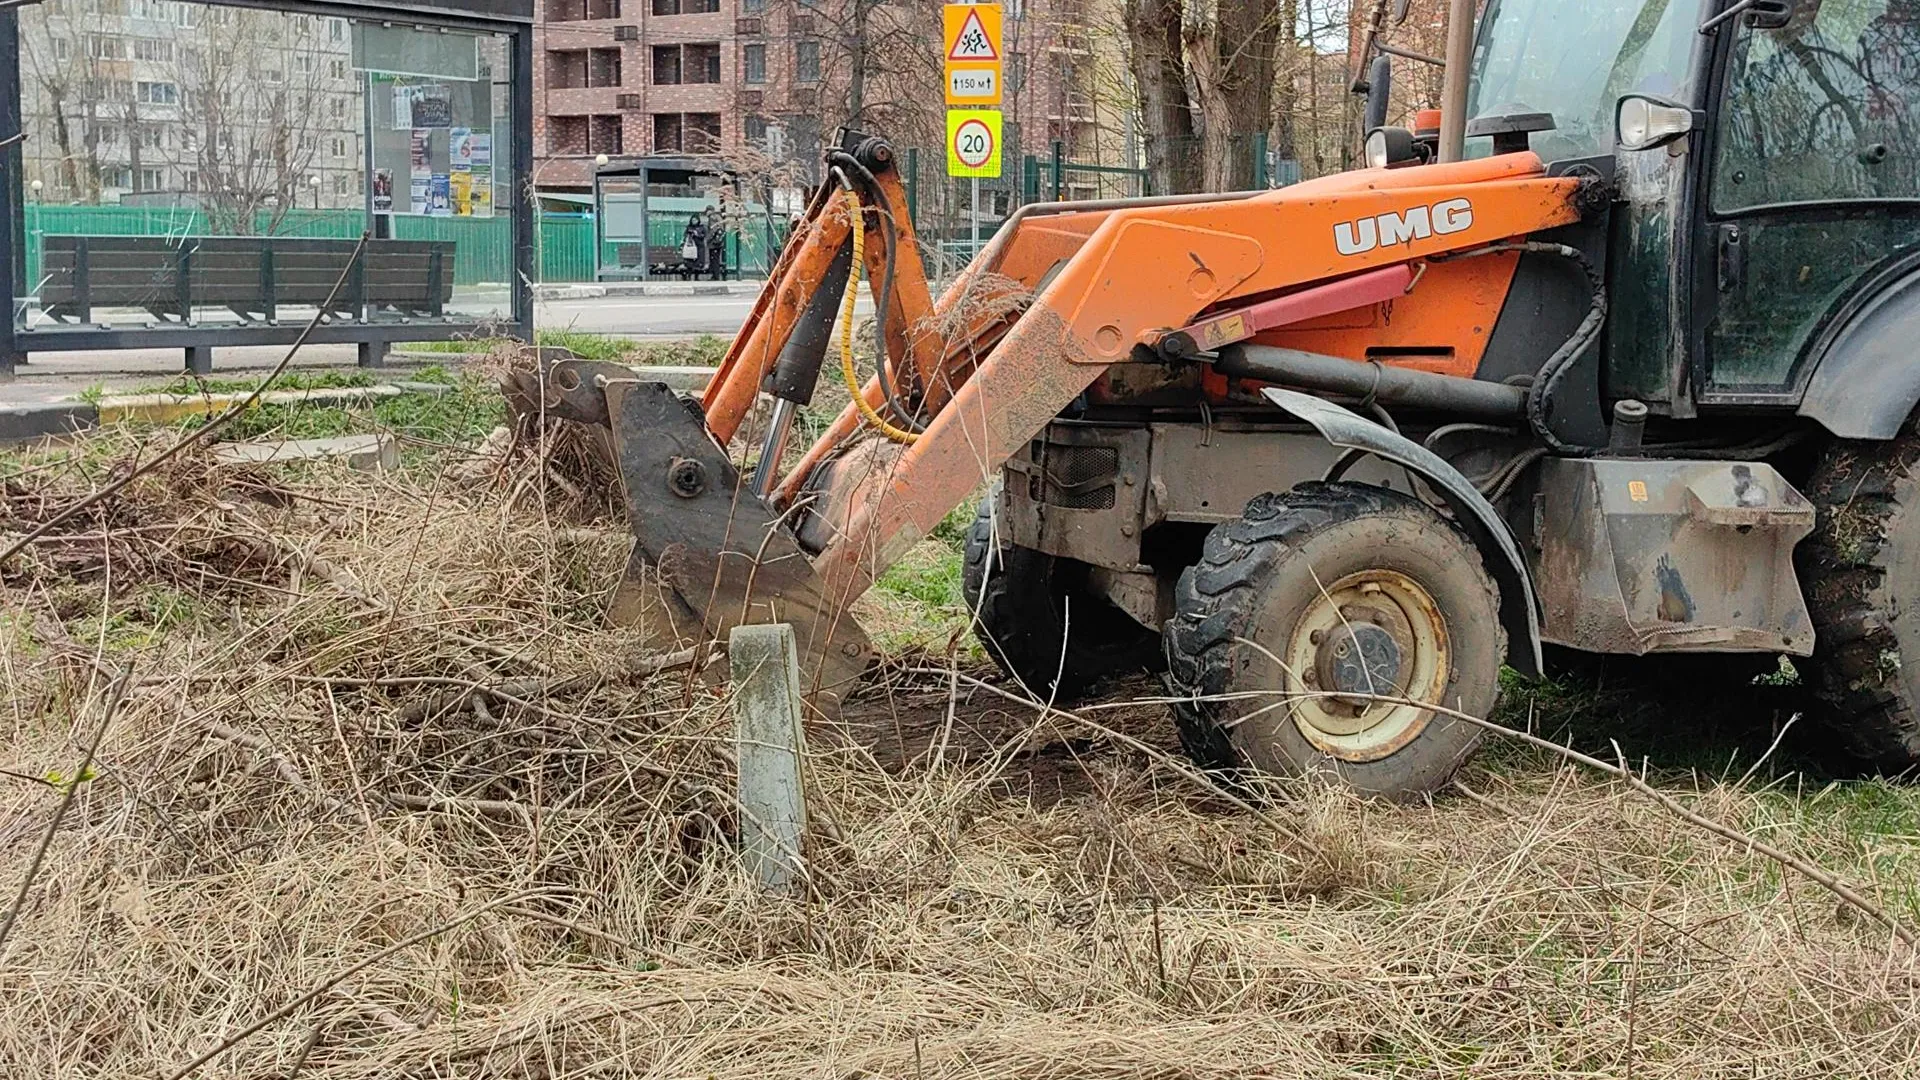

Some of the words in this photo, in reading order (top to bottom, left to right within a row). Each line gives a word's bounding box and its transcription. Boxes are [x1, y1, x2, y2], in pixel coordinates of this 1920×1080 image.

[960, 79, 975, 88] 150
[963, 134, 984, 153] 20
[1333, 197, 1474, 256] UMG
